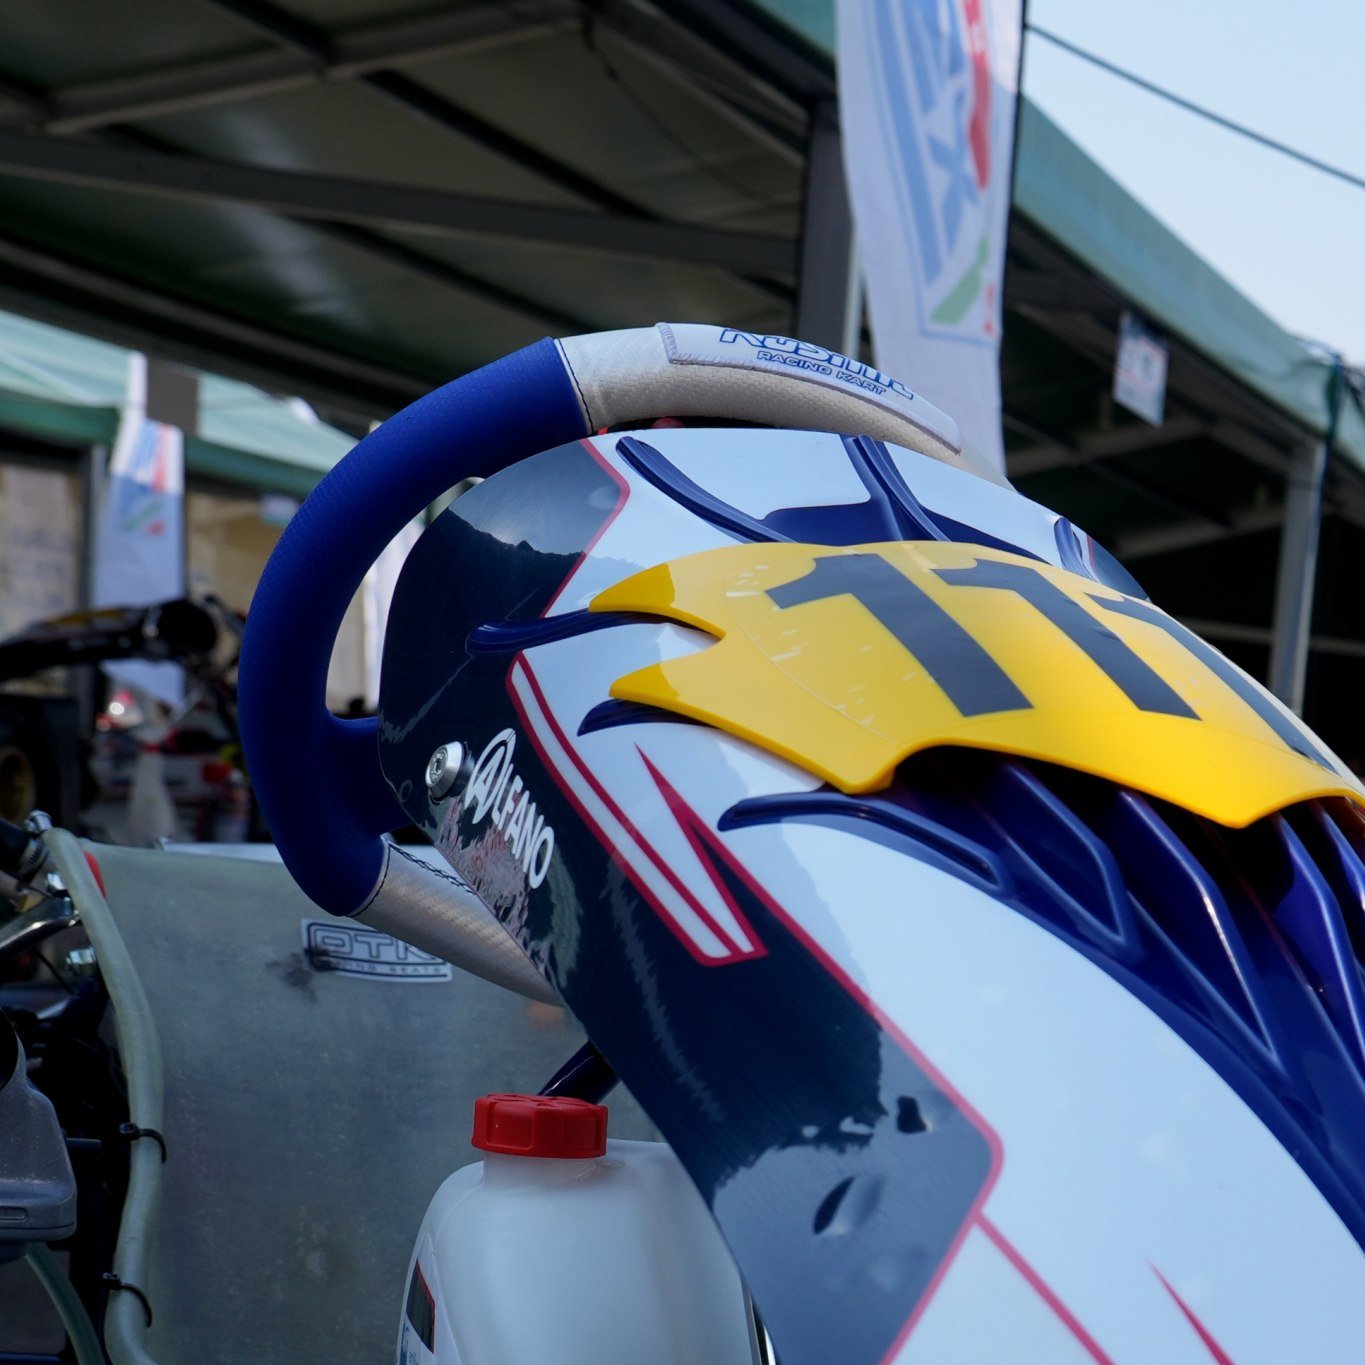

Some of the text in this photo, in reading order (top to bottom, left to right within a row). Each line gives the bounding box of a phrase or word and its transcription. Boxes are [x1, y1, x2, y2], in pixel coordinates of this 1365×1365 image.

[757, 350, 887, 395] RACING KART
[464, 727, 555, 889] ALFANO
